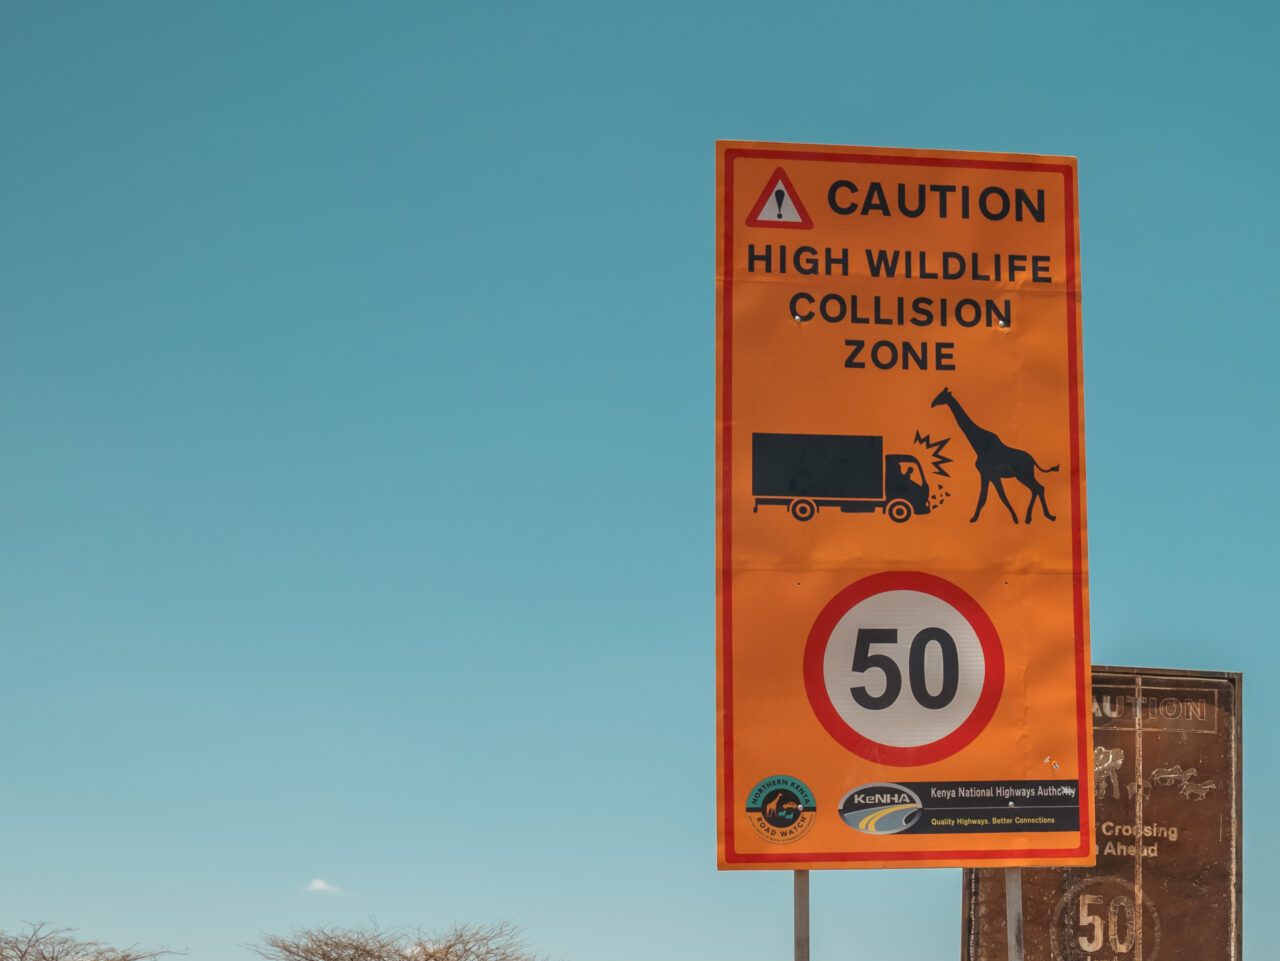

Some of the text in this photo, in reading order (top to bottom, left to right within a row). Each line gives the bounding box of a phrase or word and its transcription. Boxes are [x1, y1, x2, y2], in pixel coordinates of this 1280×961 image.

[827, 179, 1046, 223] CAUTION
[747, 244, 1052, 283] HIGH WILDLIFE
[789, 292, 1012, 328] COLLISION
[844, 339, 956, 371] ZONE
[850, 627, 959, 710] 50
[751, 779, 811, 805] NORTHERN KENYA
[854, 793, 911, 804] KeNHA
[930, 787, 956, 799] Kenya
[958, 786, 993, 797] National
[995, 785, 1035, 799] Highways
[756, 816, 777, 836] ROAD
[780, 815, 807, 837] WATCH
[931, 818, 955, 826] Quality
[1015, 816, 1056, 824] Connections
[1101, 821, 1178, 842] Crossing
[1079, 894, 1135, 953] 50
